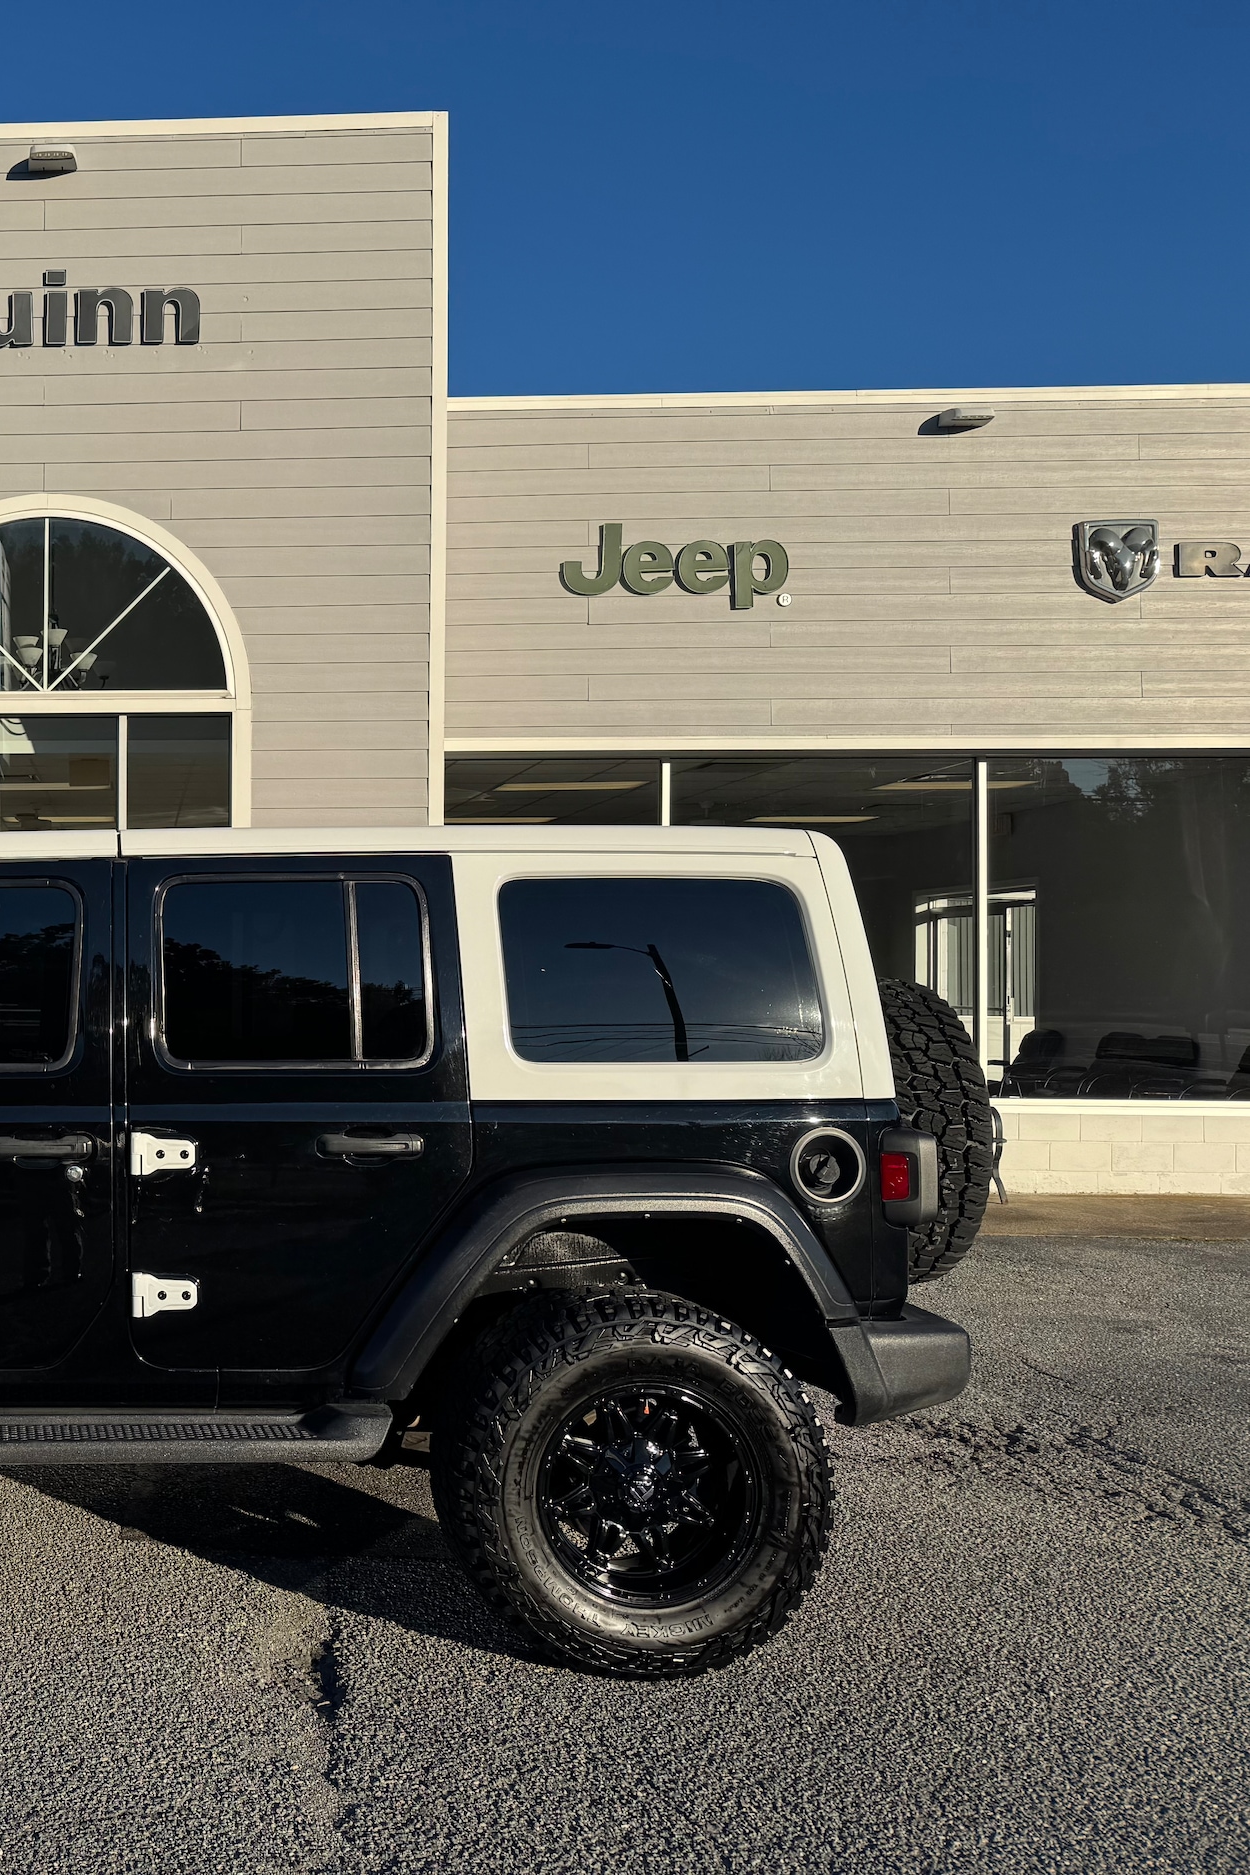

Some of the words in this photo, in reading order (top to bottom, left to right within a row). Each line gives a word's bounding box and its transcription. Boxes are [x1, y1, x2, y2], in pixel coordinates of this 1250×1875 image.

[1173, 542, 1250, 578] R
[515, 1515, 605, 1633] THOMPSON
[621, 1613, 716, 1639] MICKEY
